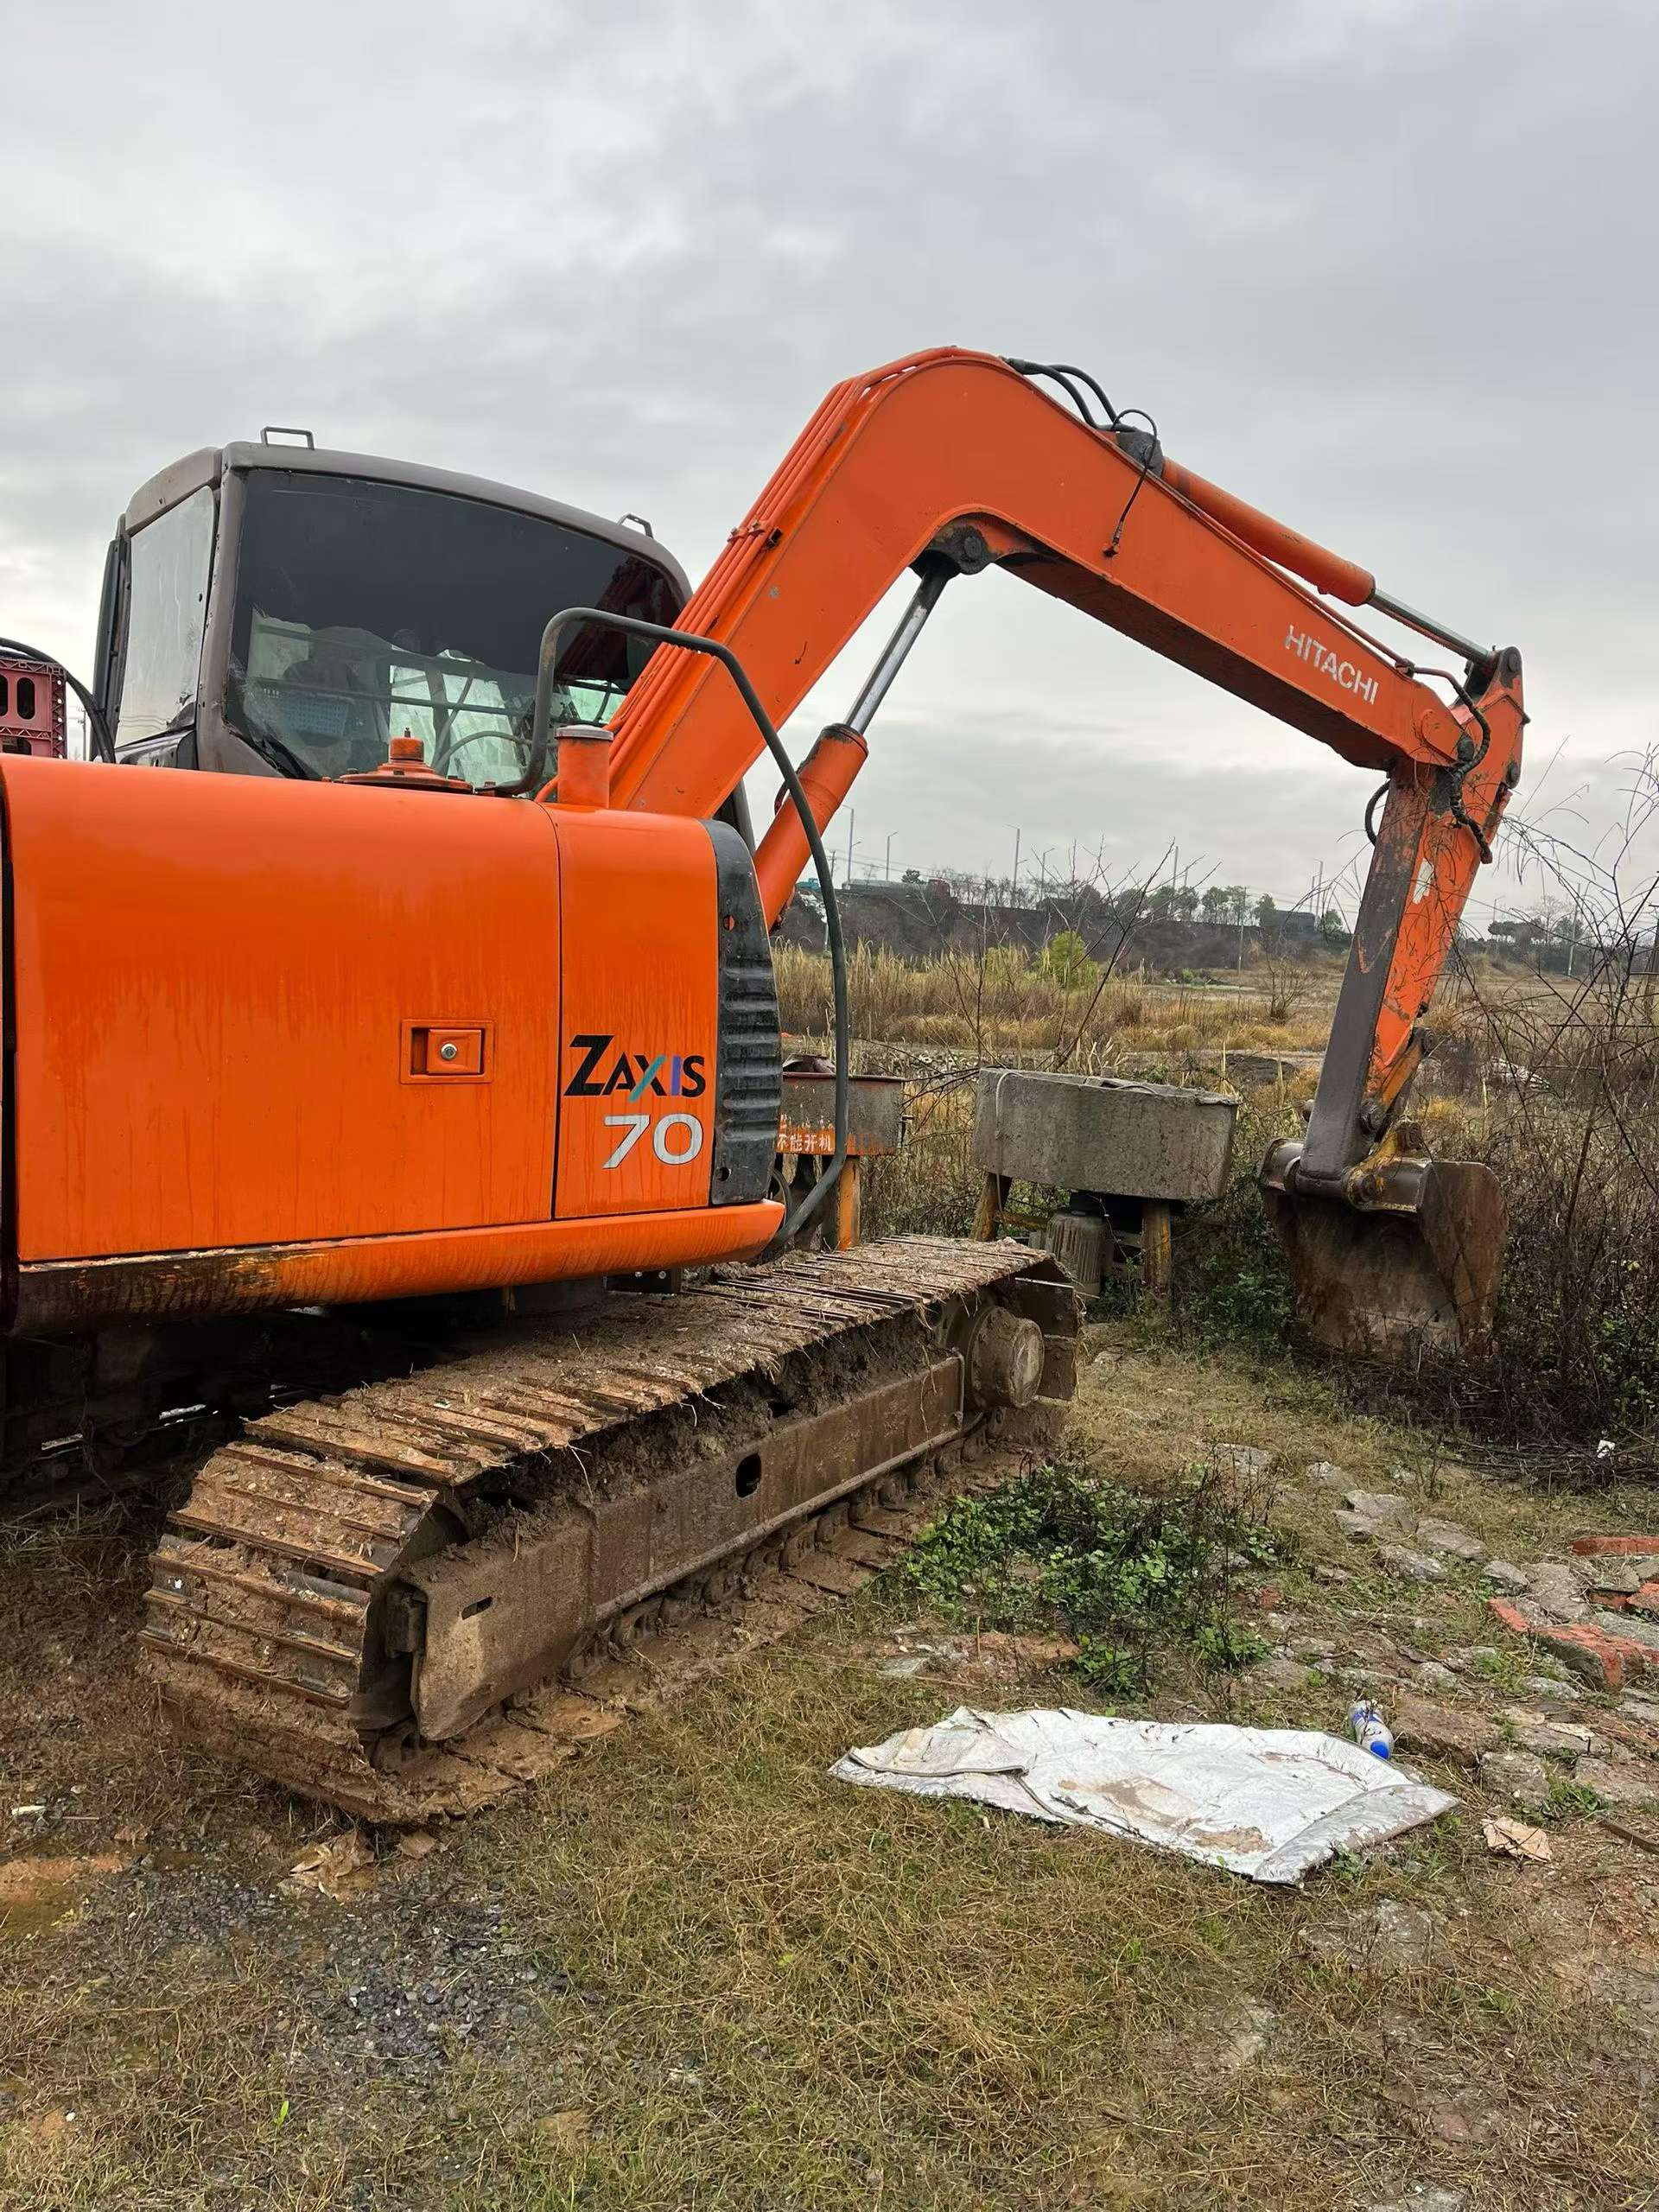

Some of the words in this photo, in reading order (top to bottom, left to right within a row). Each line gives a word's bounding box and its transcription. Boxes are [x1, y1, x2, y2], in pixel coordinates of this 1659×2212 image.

[1285, 624, 1379, 705] HITACHI
[563, 1034, 707, 1103] ZAXIS
[602, 1112, 704, 1169] 70
